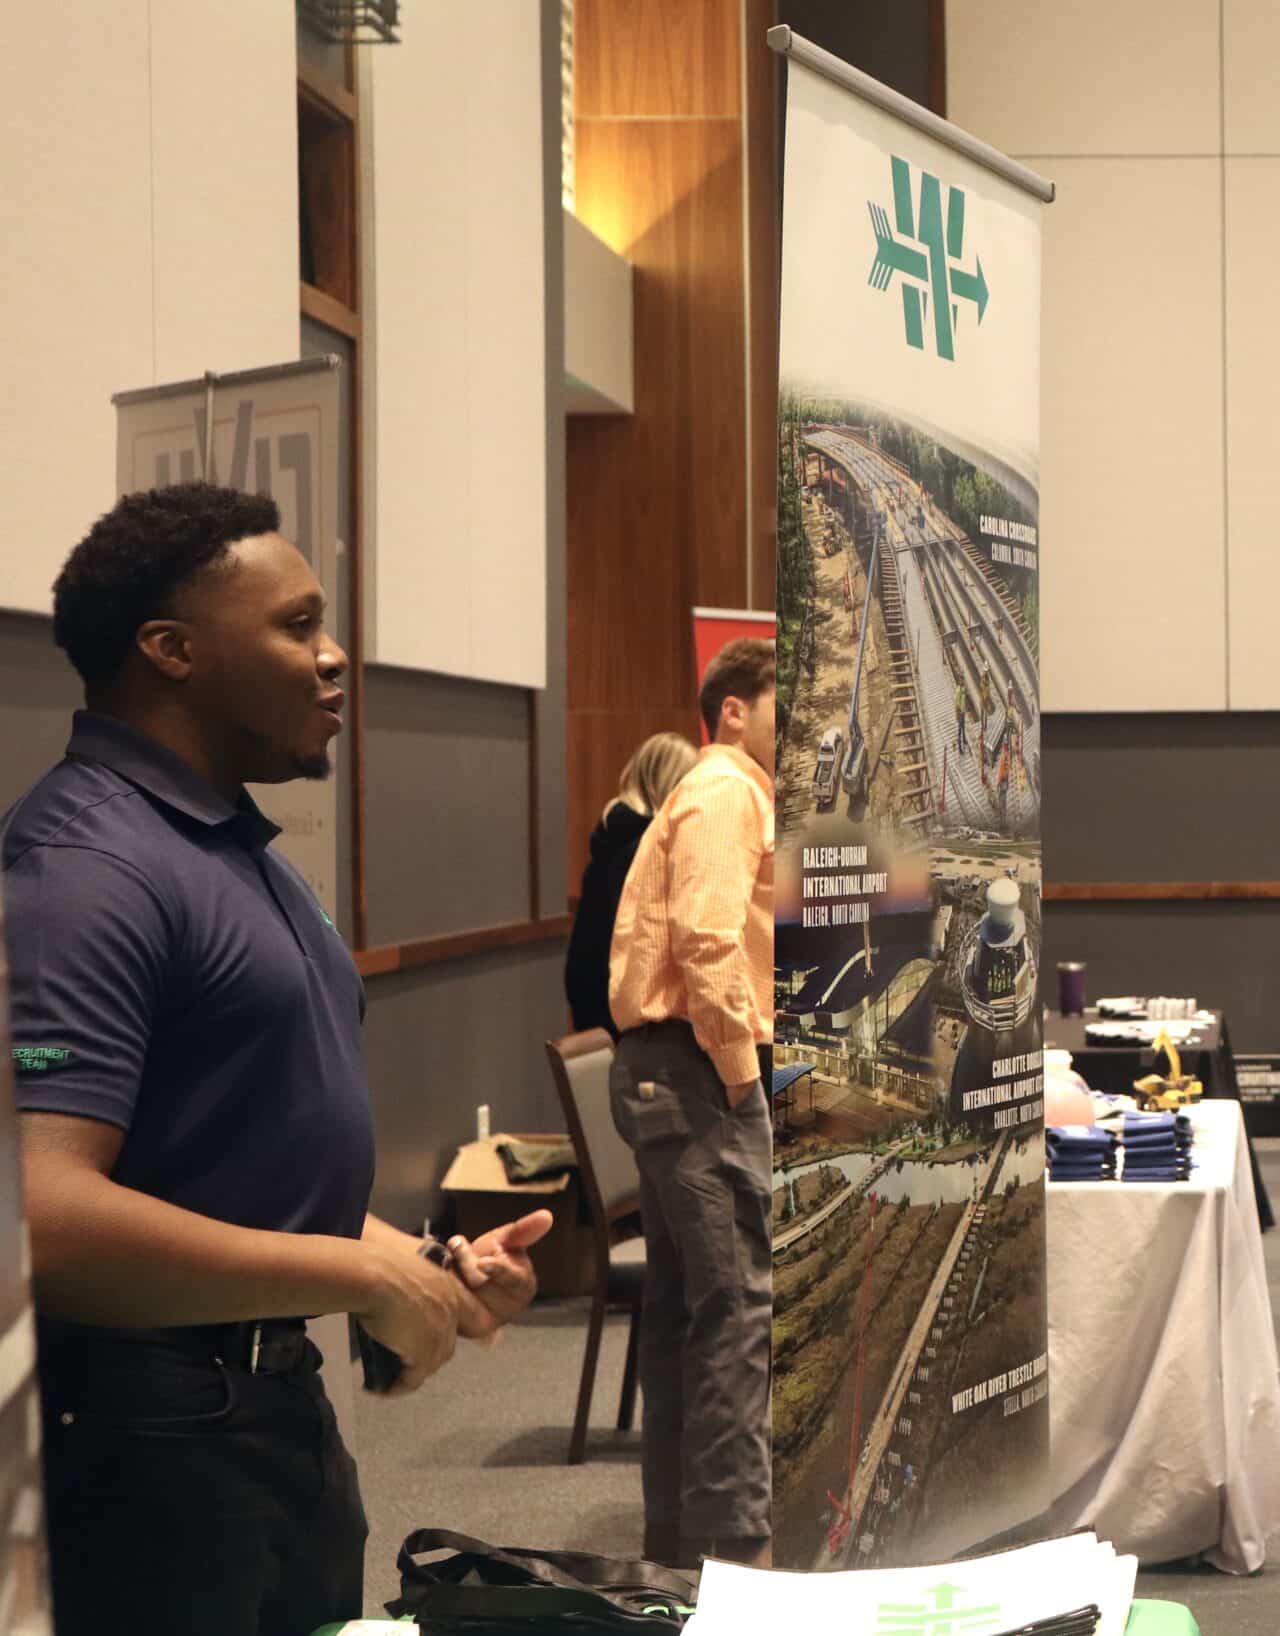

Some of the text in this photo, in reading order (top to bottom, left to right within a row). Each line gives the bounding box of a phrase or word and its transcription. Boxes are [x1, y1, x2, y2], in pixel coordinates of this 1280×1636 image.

[980, 514, 1008, 538] CAROLINA
[803, 845, 867, 868] RALEIGH-DURHAM
[803, 872, 888, 898] INTERNATIONAL AIRPORT
[20, 1058, 48, 1071] TEAM
[992, 1054, 1026, 1079] CHARLOTTE
[962, 1082, 1012, 1112] INTERNATIONAL
[1013, 1077, 1036, 1100] AIRPORT
[952, 1387, 974, 1414] WHITE
[974, 1381, 988, 1405] OAK
[988, 1373, 1008, 1398] RIVER
[1008, 1361, 1033, 1389] TRESTLE
